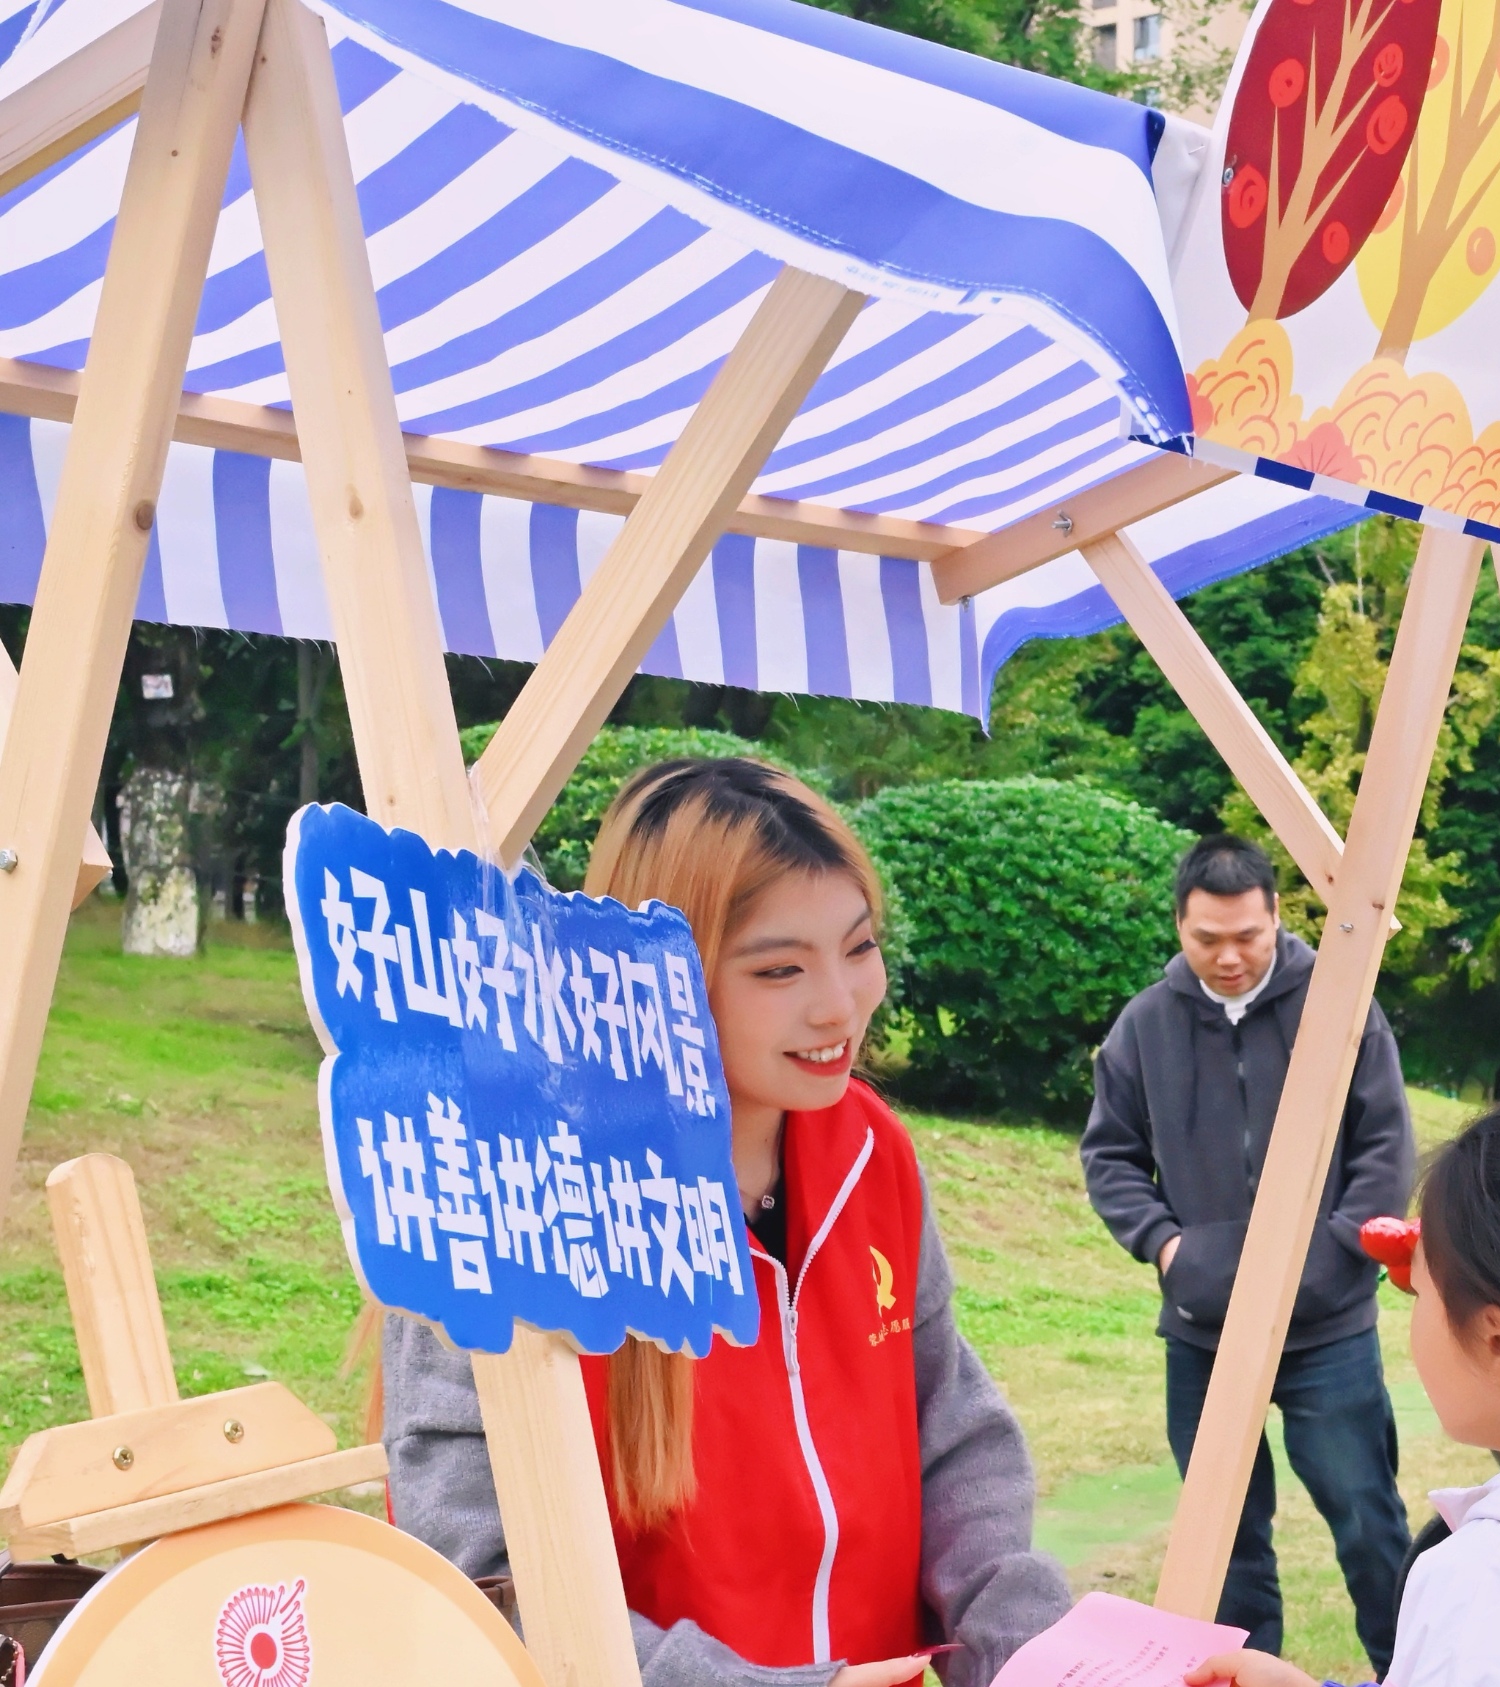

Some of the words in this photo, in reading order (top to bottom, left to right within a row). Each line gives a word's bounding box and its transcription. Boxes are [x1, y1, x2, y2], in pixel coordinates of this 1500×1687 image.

[321, 866, 716, 1117] 好山好水好风景
[357, 1092, 744, 1304] 讲善讲德讲文明
